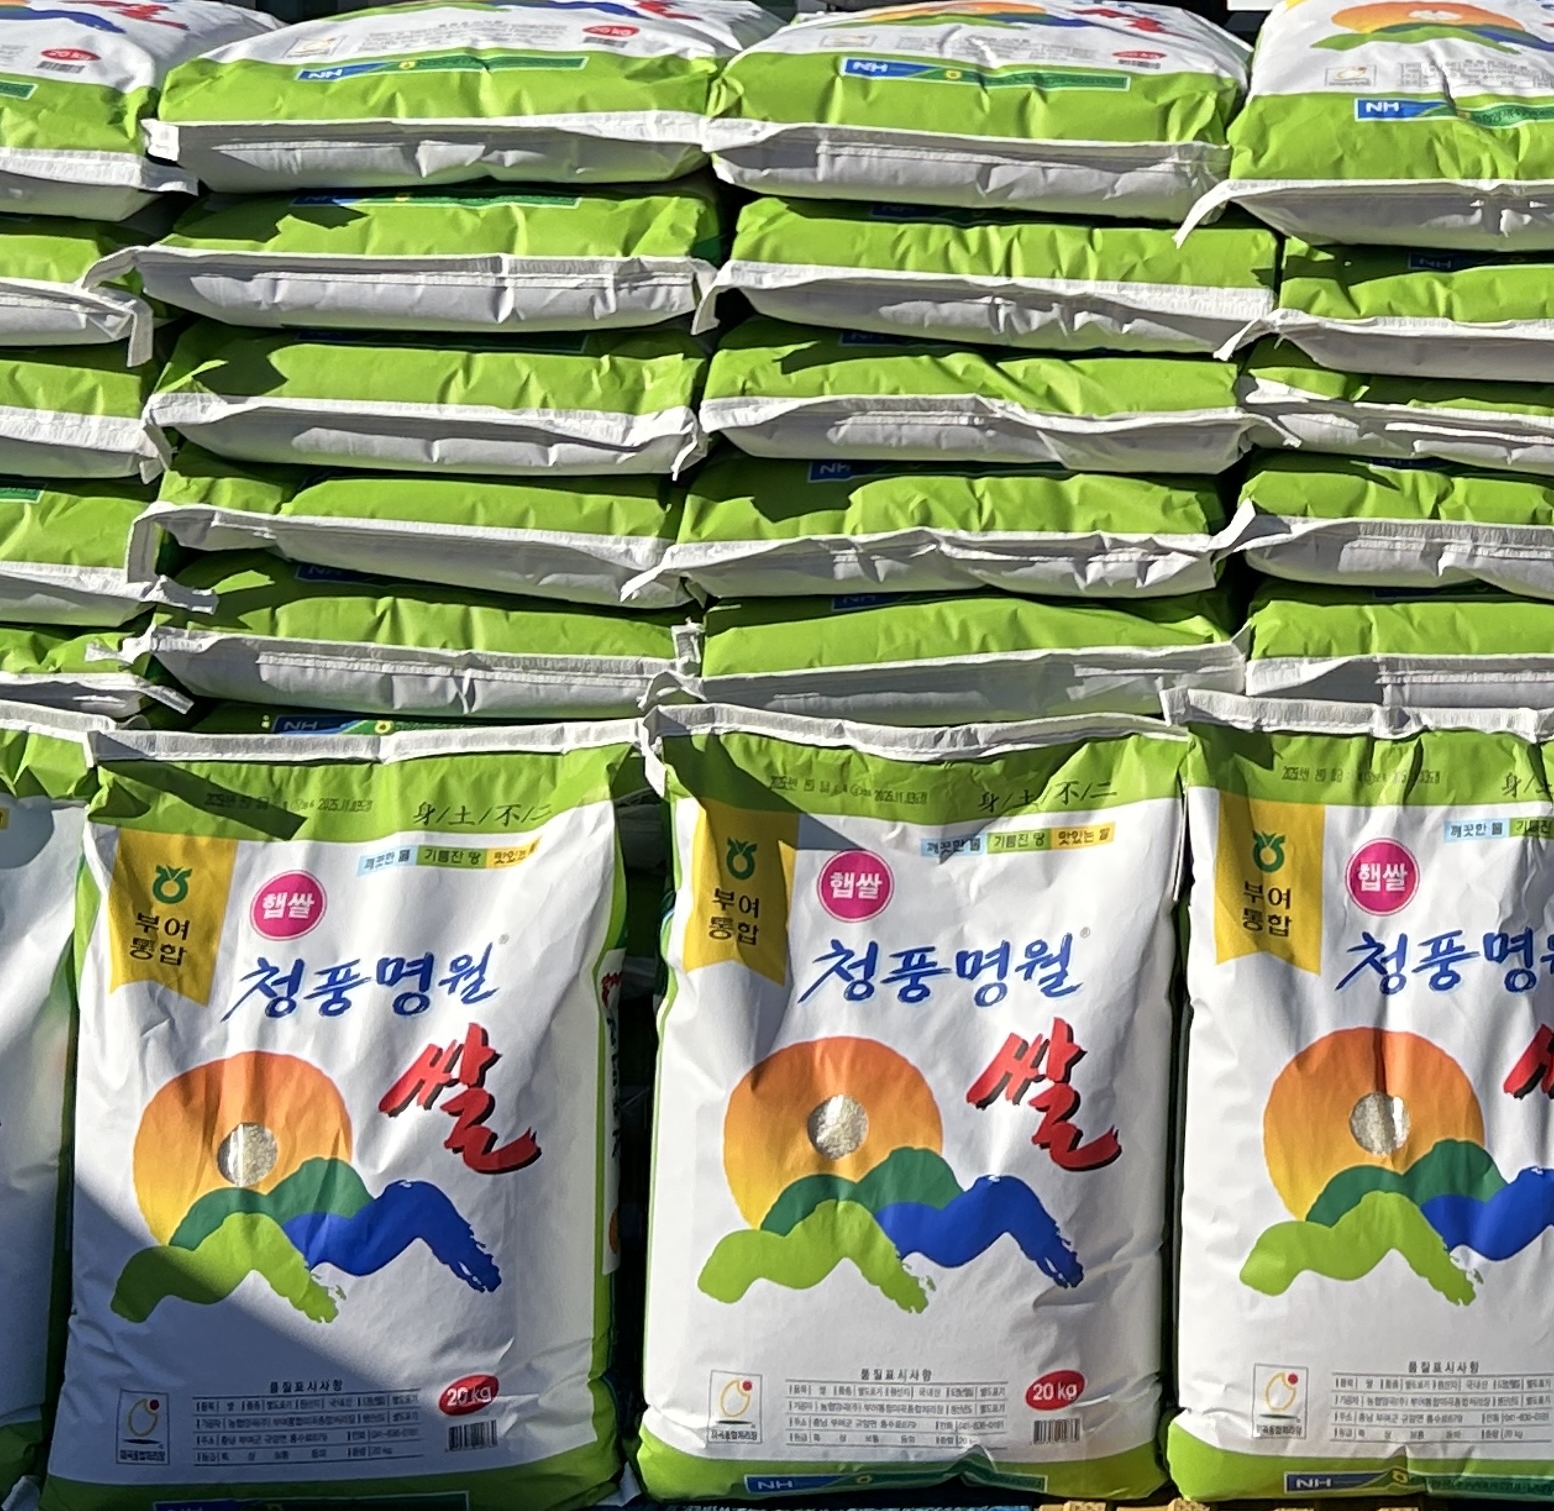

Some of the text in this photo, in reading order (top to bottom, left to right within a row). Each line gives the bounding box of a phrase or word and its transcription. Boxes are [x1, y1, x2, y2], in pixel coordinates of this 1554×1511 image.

[308, 69, 343, 79] NH
[852, 61, 888, 73] NH
[1366, 101, 1399, 112] NH
[284, 720, 318, 730] NH
[993, 834, 1029, 848] 기름진
[1058, 830, 1094, 845] 맛있는
[1450, 824, 1487, 838] 깨끗한
[830, 873, 882, 900] 햅쌀
[1358, 864, 1408, 892] 햅쌀
[262, 891, 315, 921] 햅쌀
[712, 889, 760, 918] 부여
[1243, 880, 1292, 910] 부여
[135, 912, 190, 942] 부여
[707, 917, 758, 945] 통합
[1241, 909, 1292, 937] 통합
[129, 939, 187, 969] 통합
[221, 943, 501, 1023] 청풍명월
[797, 932, 1086, 1008] 청풍명월
[379, 1022, 541, 1175] 쌀
[966, 1016, 1122, 1172] 쌀
[1408, 1361, 1479, 1374] 품질표시사항
[447, 1384, 492, 1406] 20 kg
[1032, 1381, 1077, 1401] 20 kg
[757, 1478, 794, 1489] NH
[1296, 1477, 1333, 1488] NH
